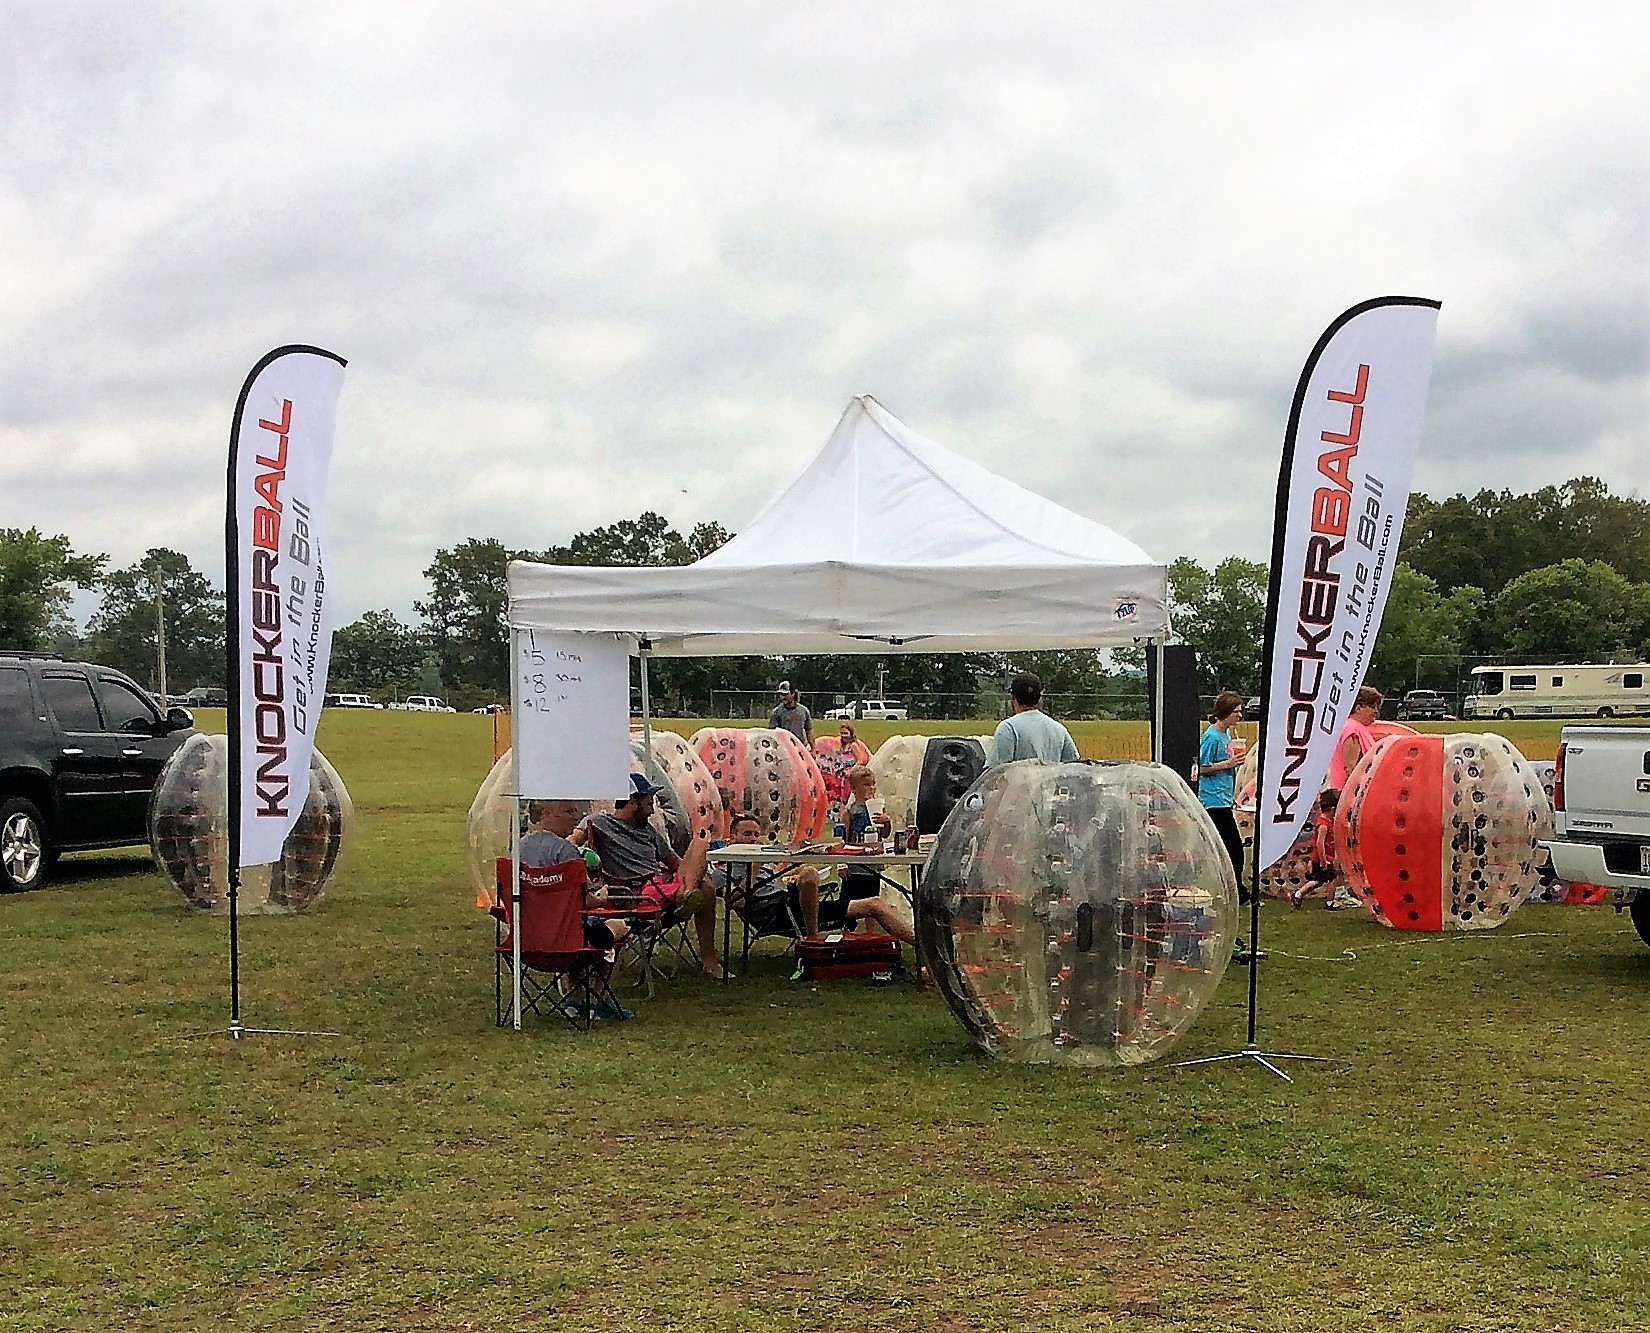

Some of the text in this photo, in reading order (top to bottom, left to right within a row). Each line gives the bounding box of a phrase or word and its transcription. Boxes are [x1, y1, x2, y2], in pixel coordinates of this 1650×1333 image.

[252, 398, 293, 818] KNOCKERBALL
[285, 498, 310, 735] Get in the Ball
[1272, 363, 1371, 824] KNOCKERBALL
[1319, 473, 1384, 735] Get in the Ball
[1349, 514, 1394, 692] www.KnockerBall.com
